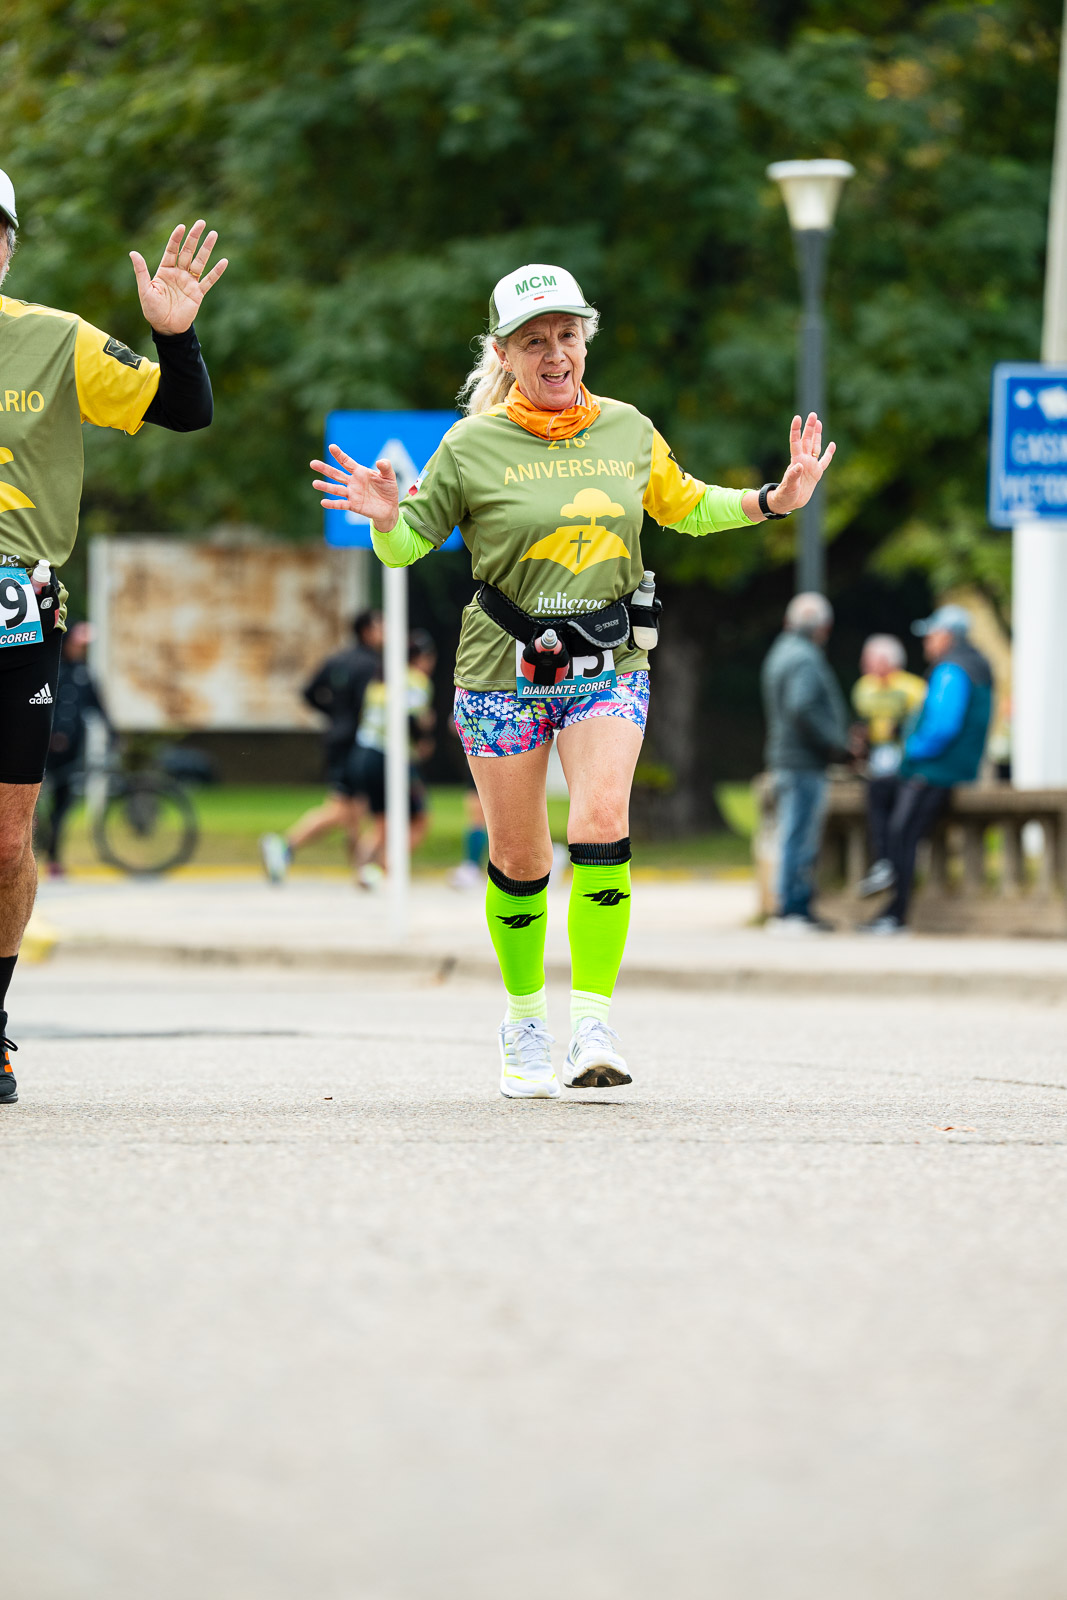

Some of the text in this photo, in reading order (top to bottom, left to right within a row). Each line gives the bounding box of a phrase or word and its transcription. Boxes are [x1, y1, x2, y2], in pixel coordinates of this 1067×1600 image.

[515, 275, 557, 296] MCM
[0, 389, 45, 413] RIO
[504, 458, 635, 486] ANIVERSARIO
[0, 631, 37, 645] CORRE
[522, 680, 611, 695] DIAMANTE CORRE
